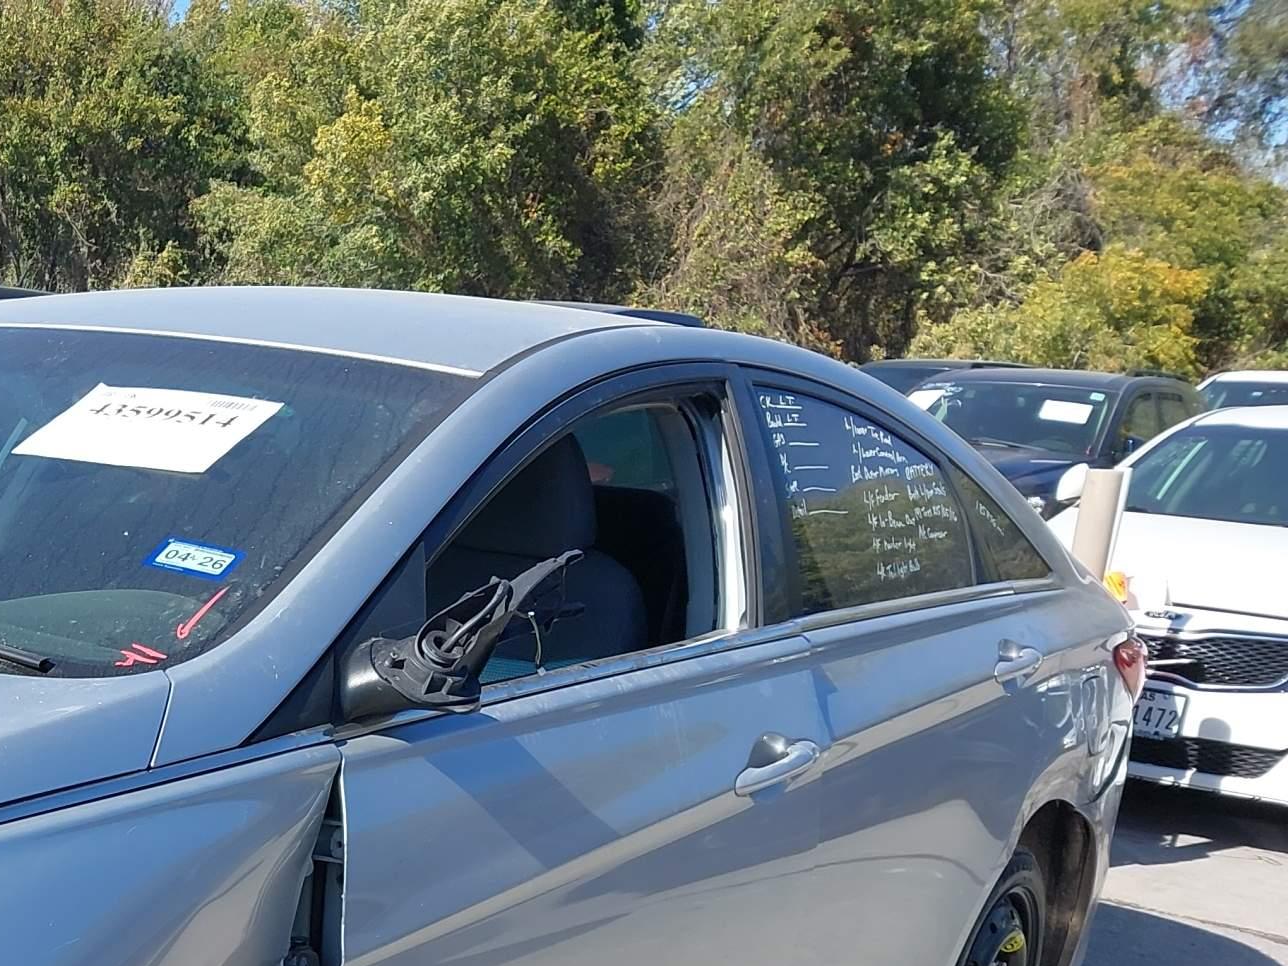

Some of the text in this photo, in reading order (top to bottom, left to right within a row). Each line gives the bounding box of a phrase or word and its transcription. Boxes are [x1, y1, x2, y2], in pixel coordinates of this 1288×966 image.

[90, 403, 240, 428] 43599514
[164, 549, 191, 562] 04
[198, 556, 228, 570] 26
